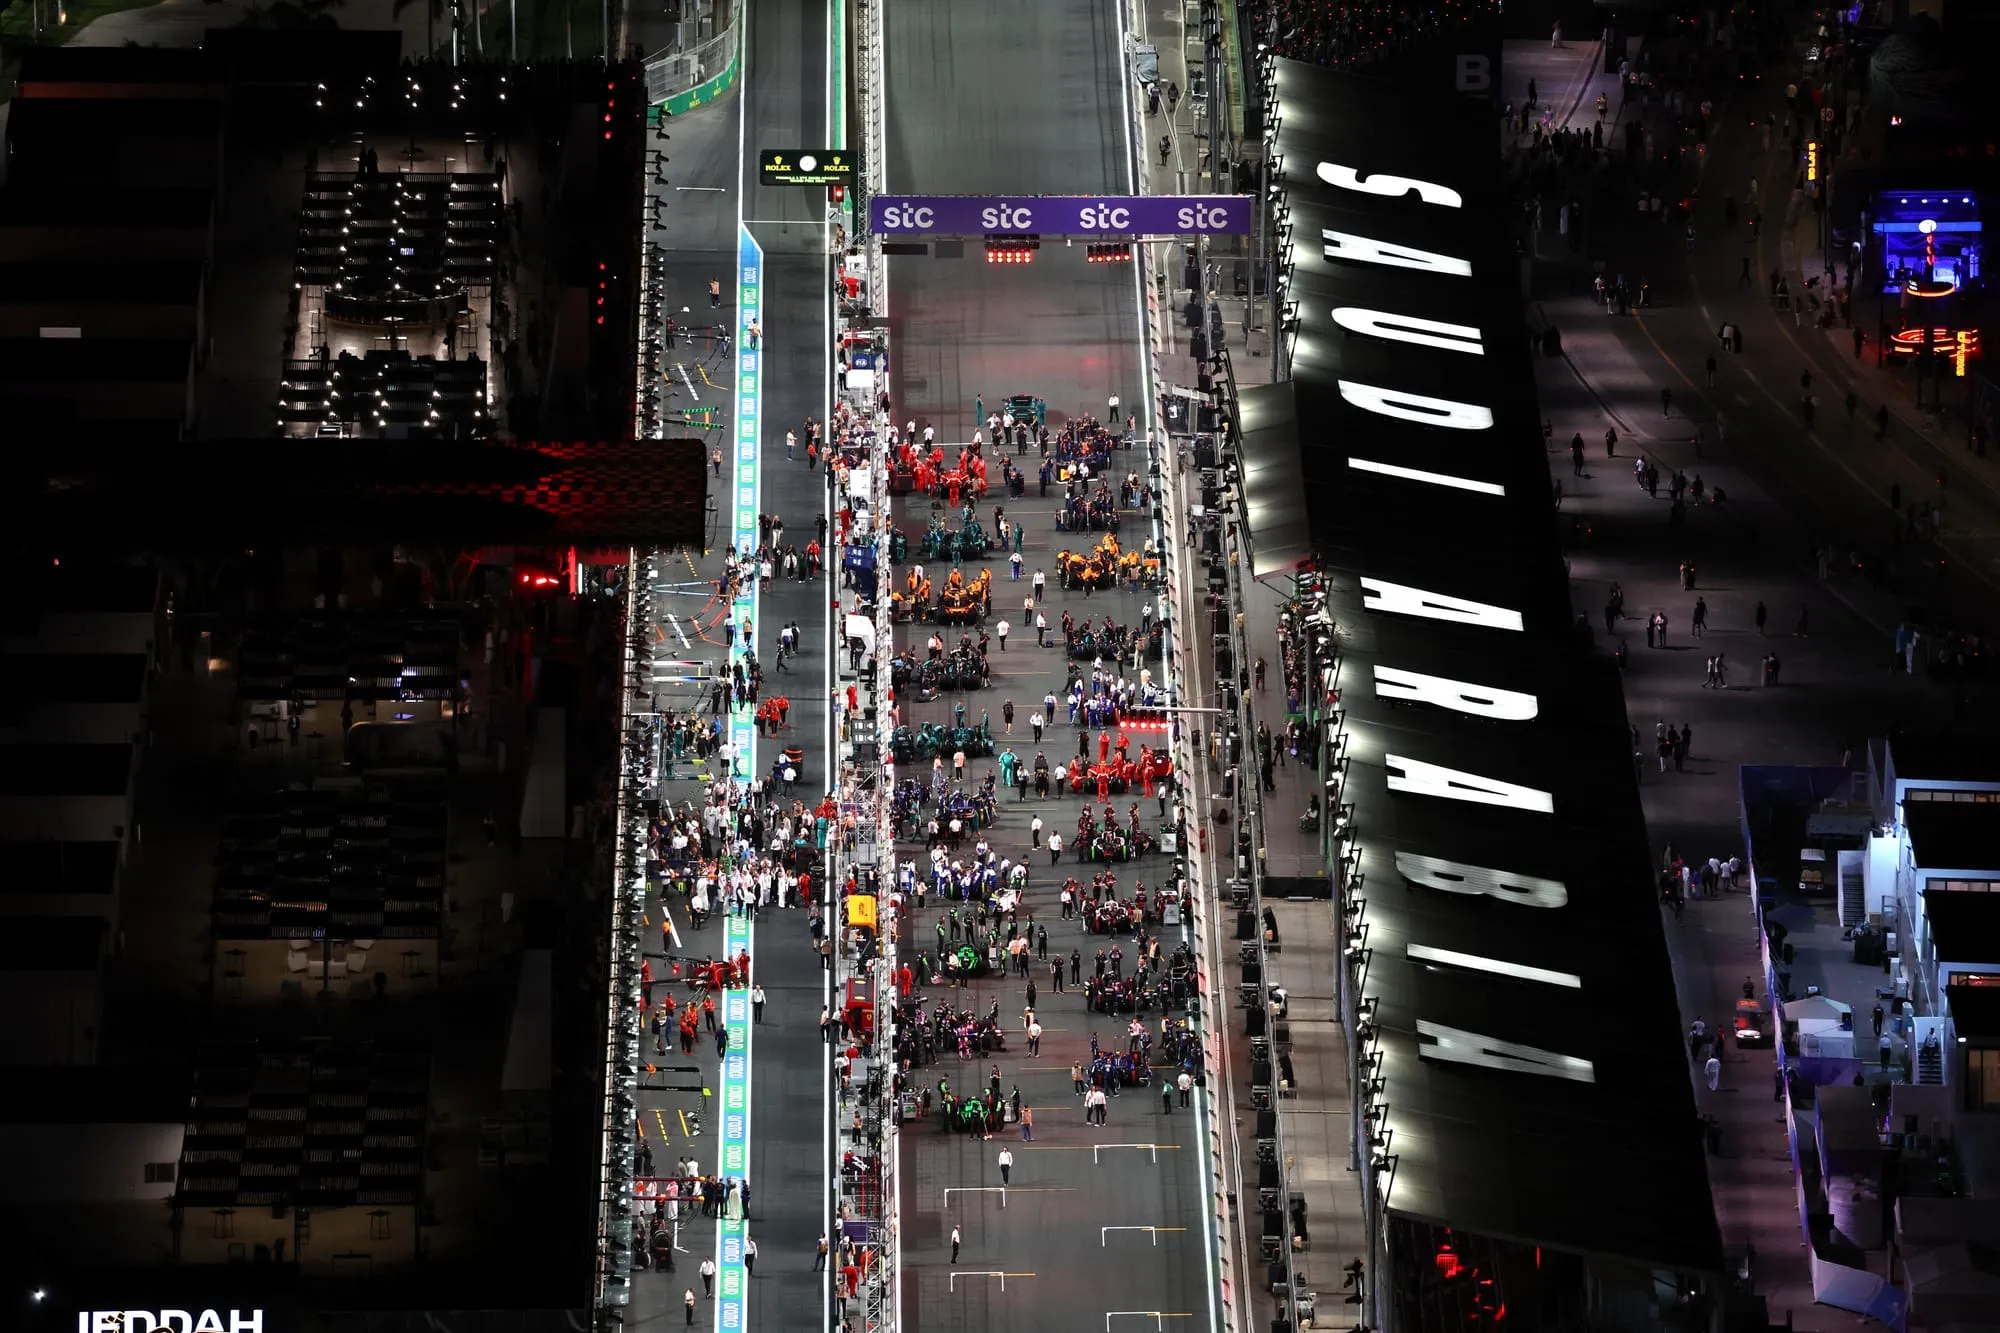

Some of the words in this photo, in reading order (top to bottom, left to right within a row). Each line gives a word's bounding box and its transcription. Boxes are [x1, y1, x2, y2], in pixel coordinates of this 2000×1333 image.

[1456, 54, 1491, 91] B
[884, 203, 934, 229] stc
[982, 203, 1032, 229] stc
[1079, 203, 1130, 229] stc
[1177, 203, 1228, 229] stc
[1316, 161, 1506, 497] SAUDI
[1360, 576, 1596, 1084] ARABIA
[730, 998, 744, 1020] aramco
[729, 1027, 744, 1049] aramco
[728, 1055, 743, 1078] aramco
[728, 1085, 743, 1108] aramco
[727, 1115, 742, 1138] aramco
[727, 1145, 742, 1168] aramco
[725, 1238, 740, 1262] aramco
[723, 1270, 740, 1295] aramco
[722, 1302, 739, 1328] aramco
